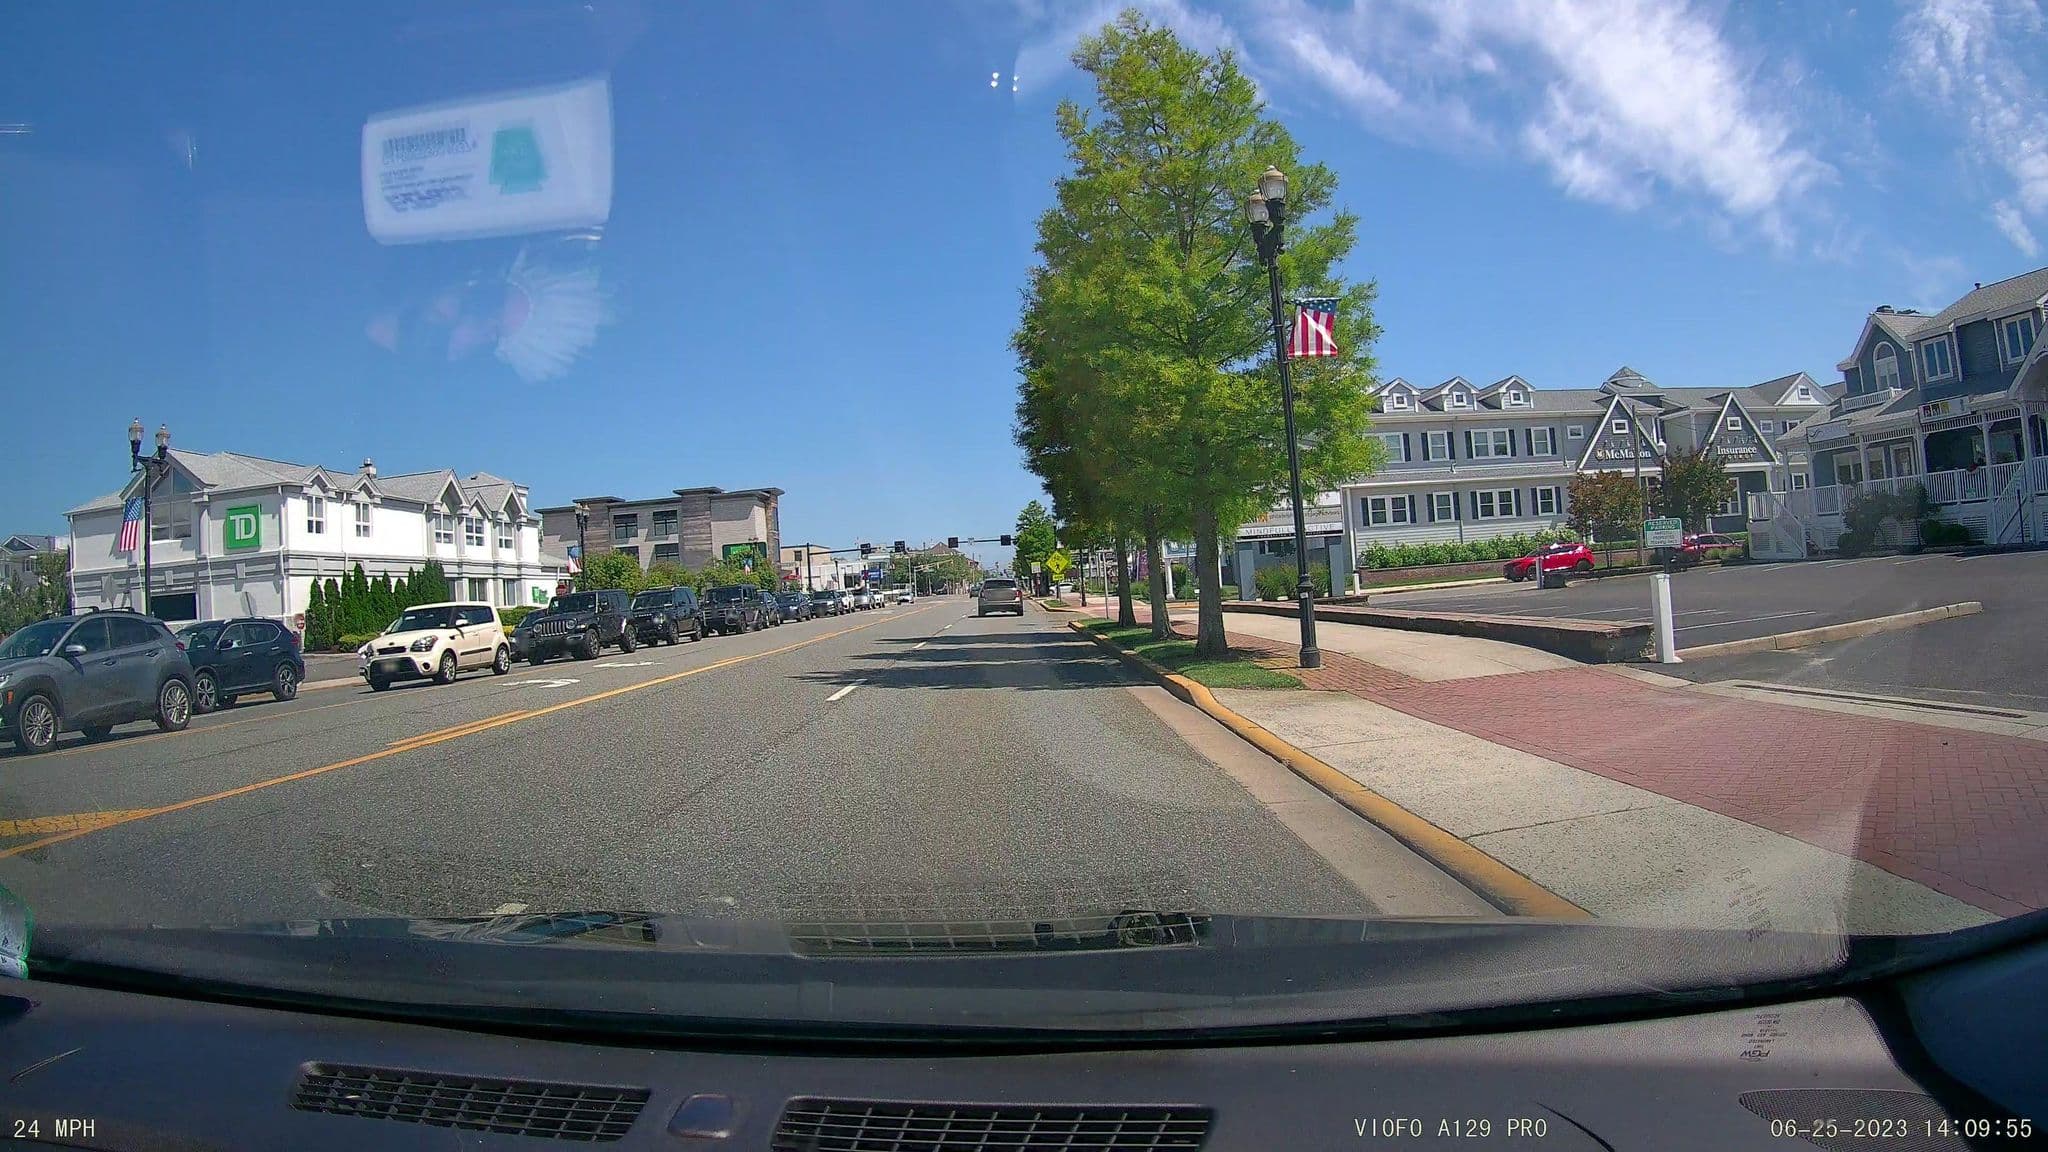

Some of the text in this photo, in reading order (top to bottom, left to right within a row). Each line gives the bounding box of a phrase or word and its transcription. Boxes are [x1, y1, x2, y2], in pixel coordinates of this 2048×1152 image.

[1605, 448, 1651, 460] McMaon
[1717, 445, 1757, 455] Insurance
[230, 514, 256, 540] TD
